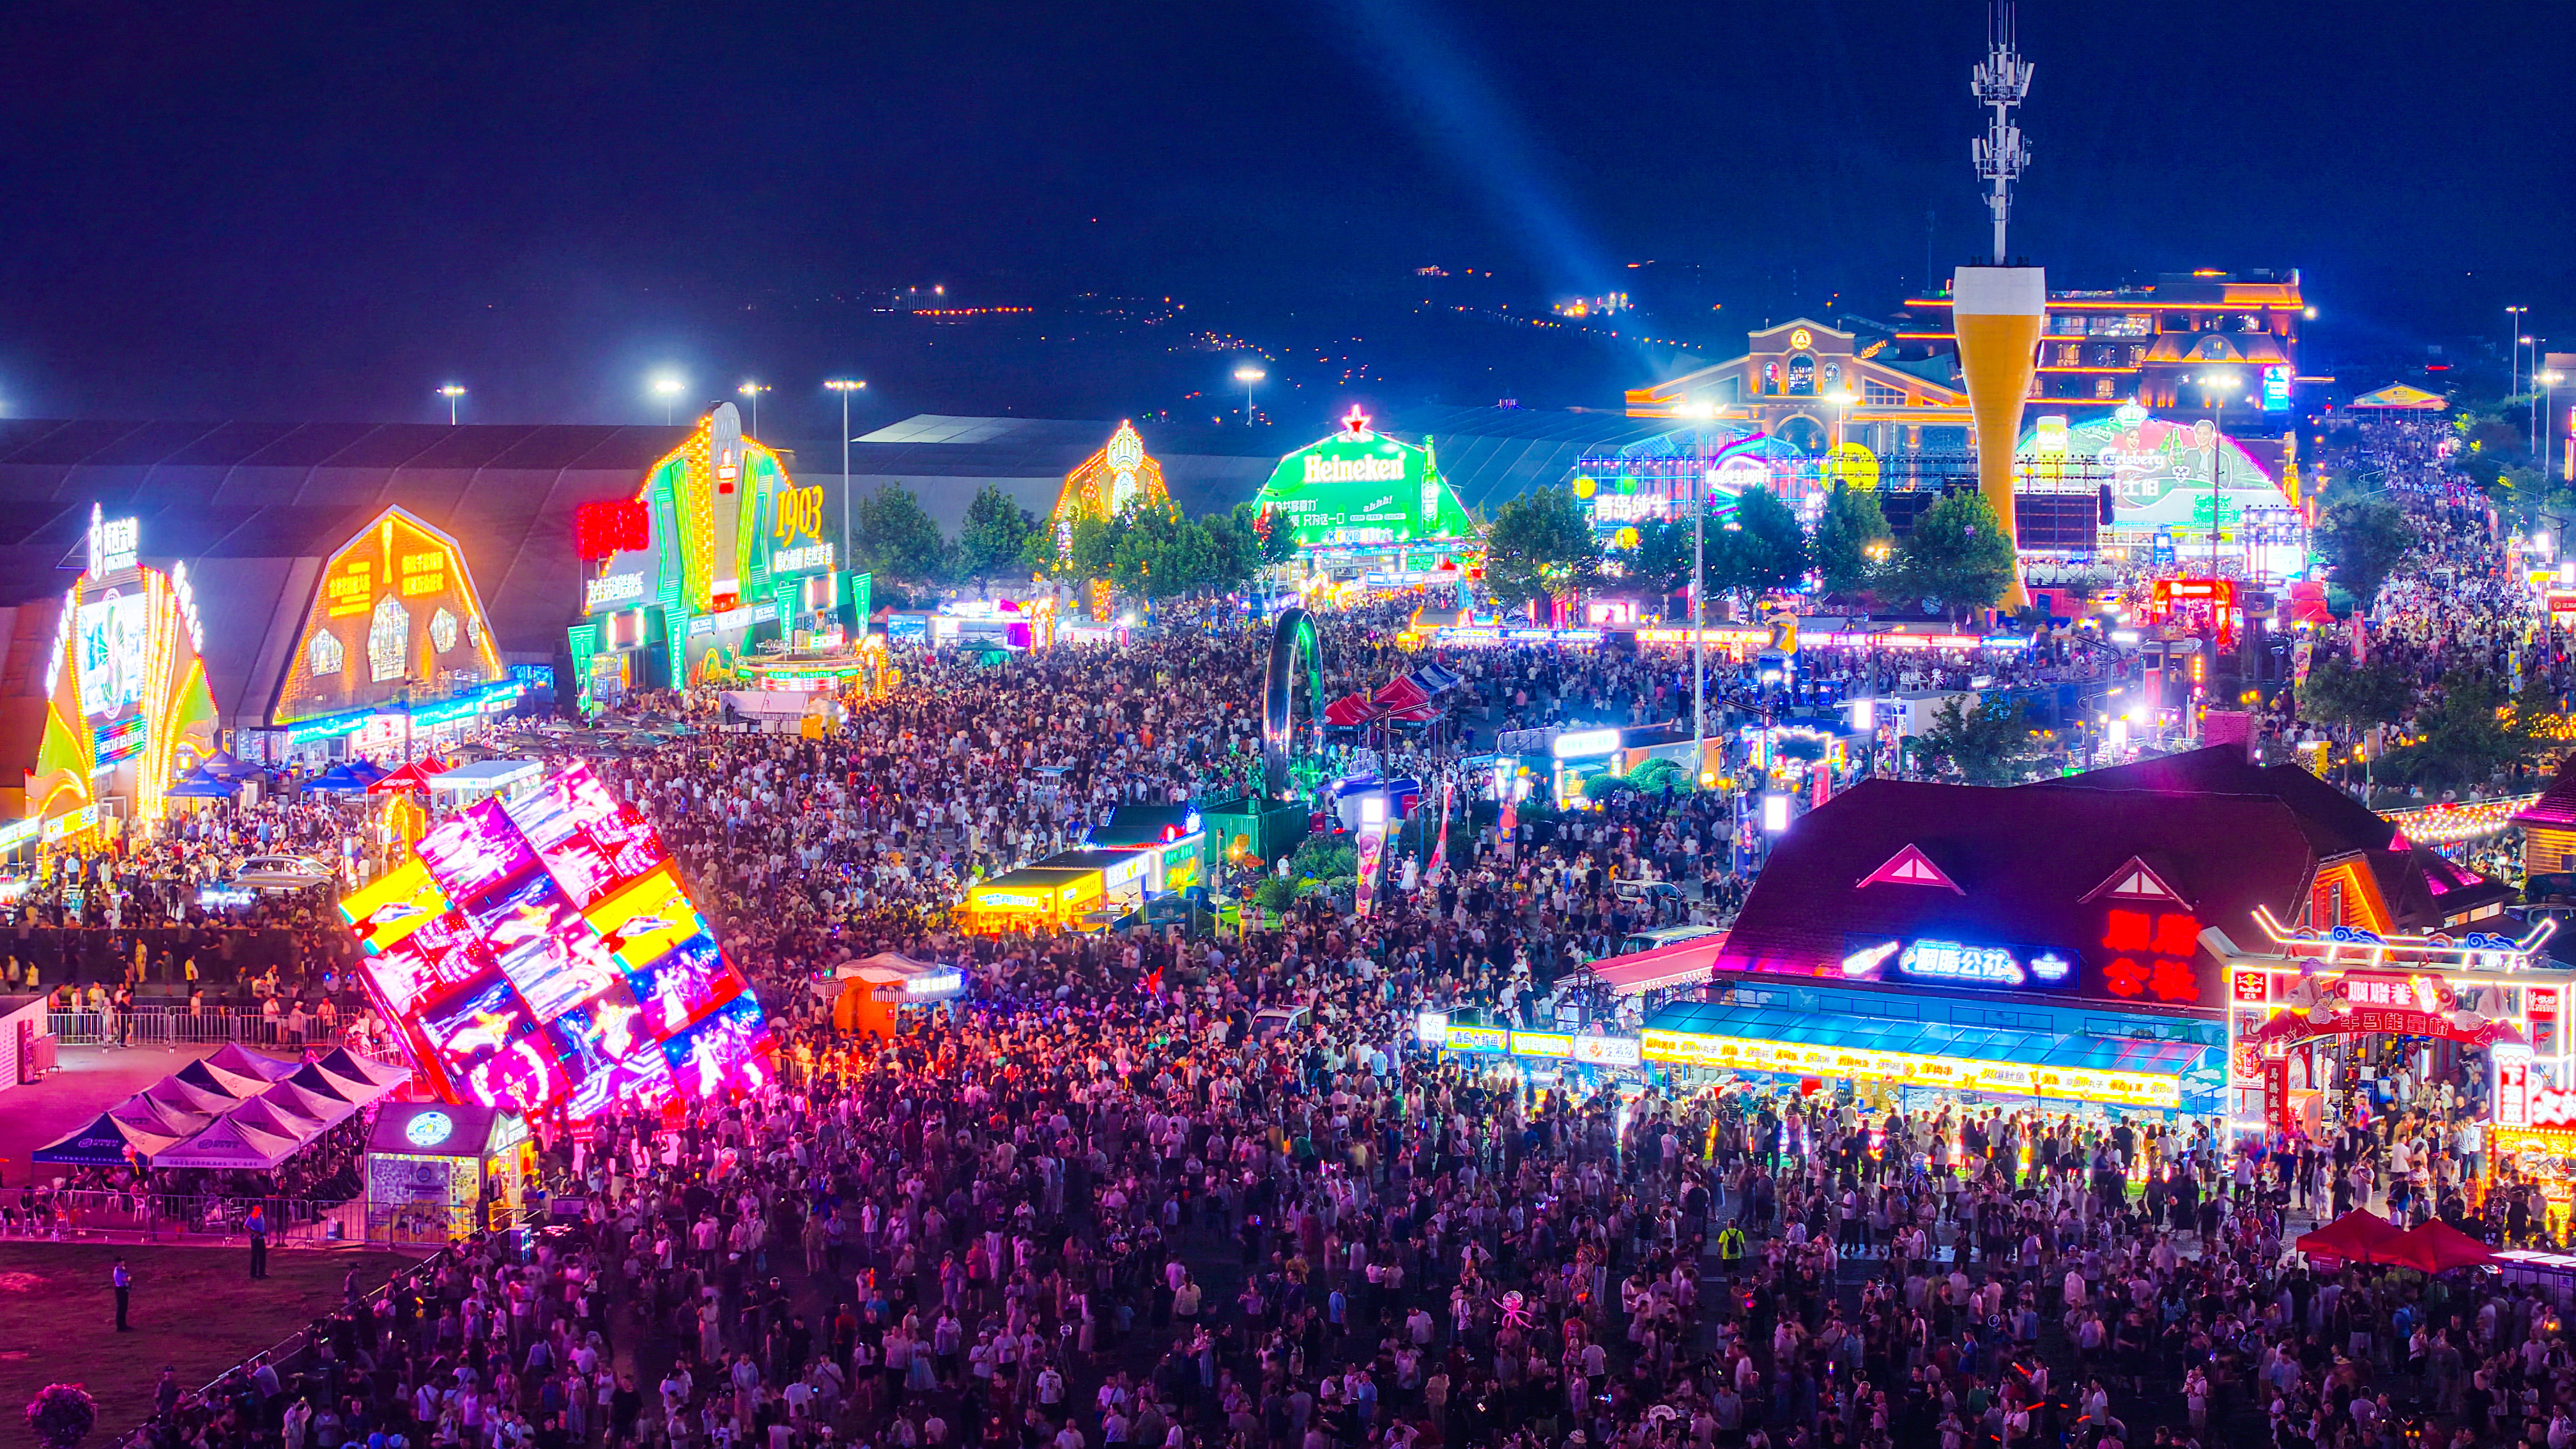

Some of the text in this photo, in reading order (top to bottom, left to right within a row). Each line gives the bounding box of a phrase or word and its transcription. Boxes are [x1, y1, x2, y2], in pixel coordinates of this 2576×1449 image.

[1303, 454, 1405, 483] Heineken
[2098, 448, 2165, 471] Carlsberg
[1363, 495, 1393, 512] ahhh!
[1595, 494, 1667, 521] 青岛纯生
[774, 484, 824, 547] 1903
[1303, 512, 1344, 526] 只为这一口
[804, 543, 833, 567] 传世麦香
[587, 571, 644, 603] 为生活创造快乐
[1915, 948, 2004, 976] 胭脂公社
[2031, 959, 2067, 973] TSINGTAO
[2348, 981, 2412, 1004] 胭脂巷
[2341, 1013, 2449, 1036] 牛马能量桥
[1454, 1031, 1499, 1047] 青岛大鱿鱼
[1606, 1042, 1635, 1057] 生煎包
[1682, 1043, 1718, 1054] 章鱼小丸子
[1923, 1063, 1953, 1077] 羊肉串
[1983, 1068, 2025, 1083] 火爆鱿鱼
[2066, 1077, 2104, 1088] 章鱼小丸子
[2503, 1067, 2524, 1122] 下酒菜
